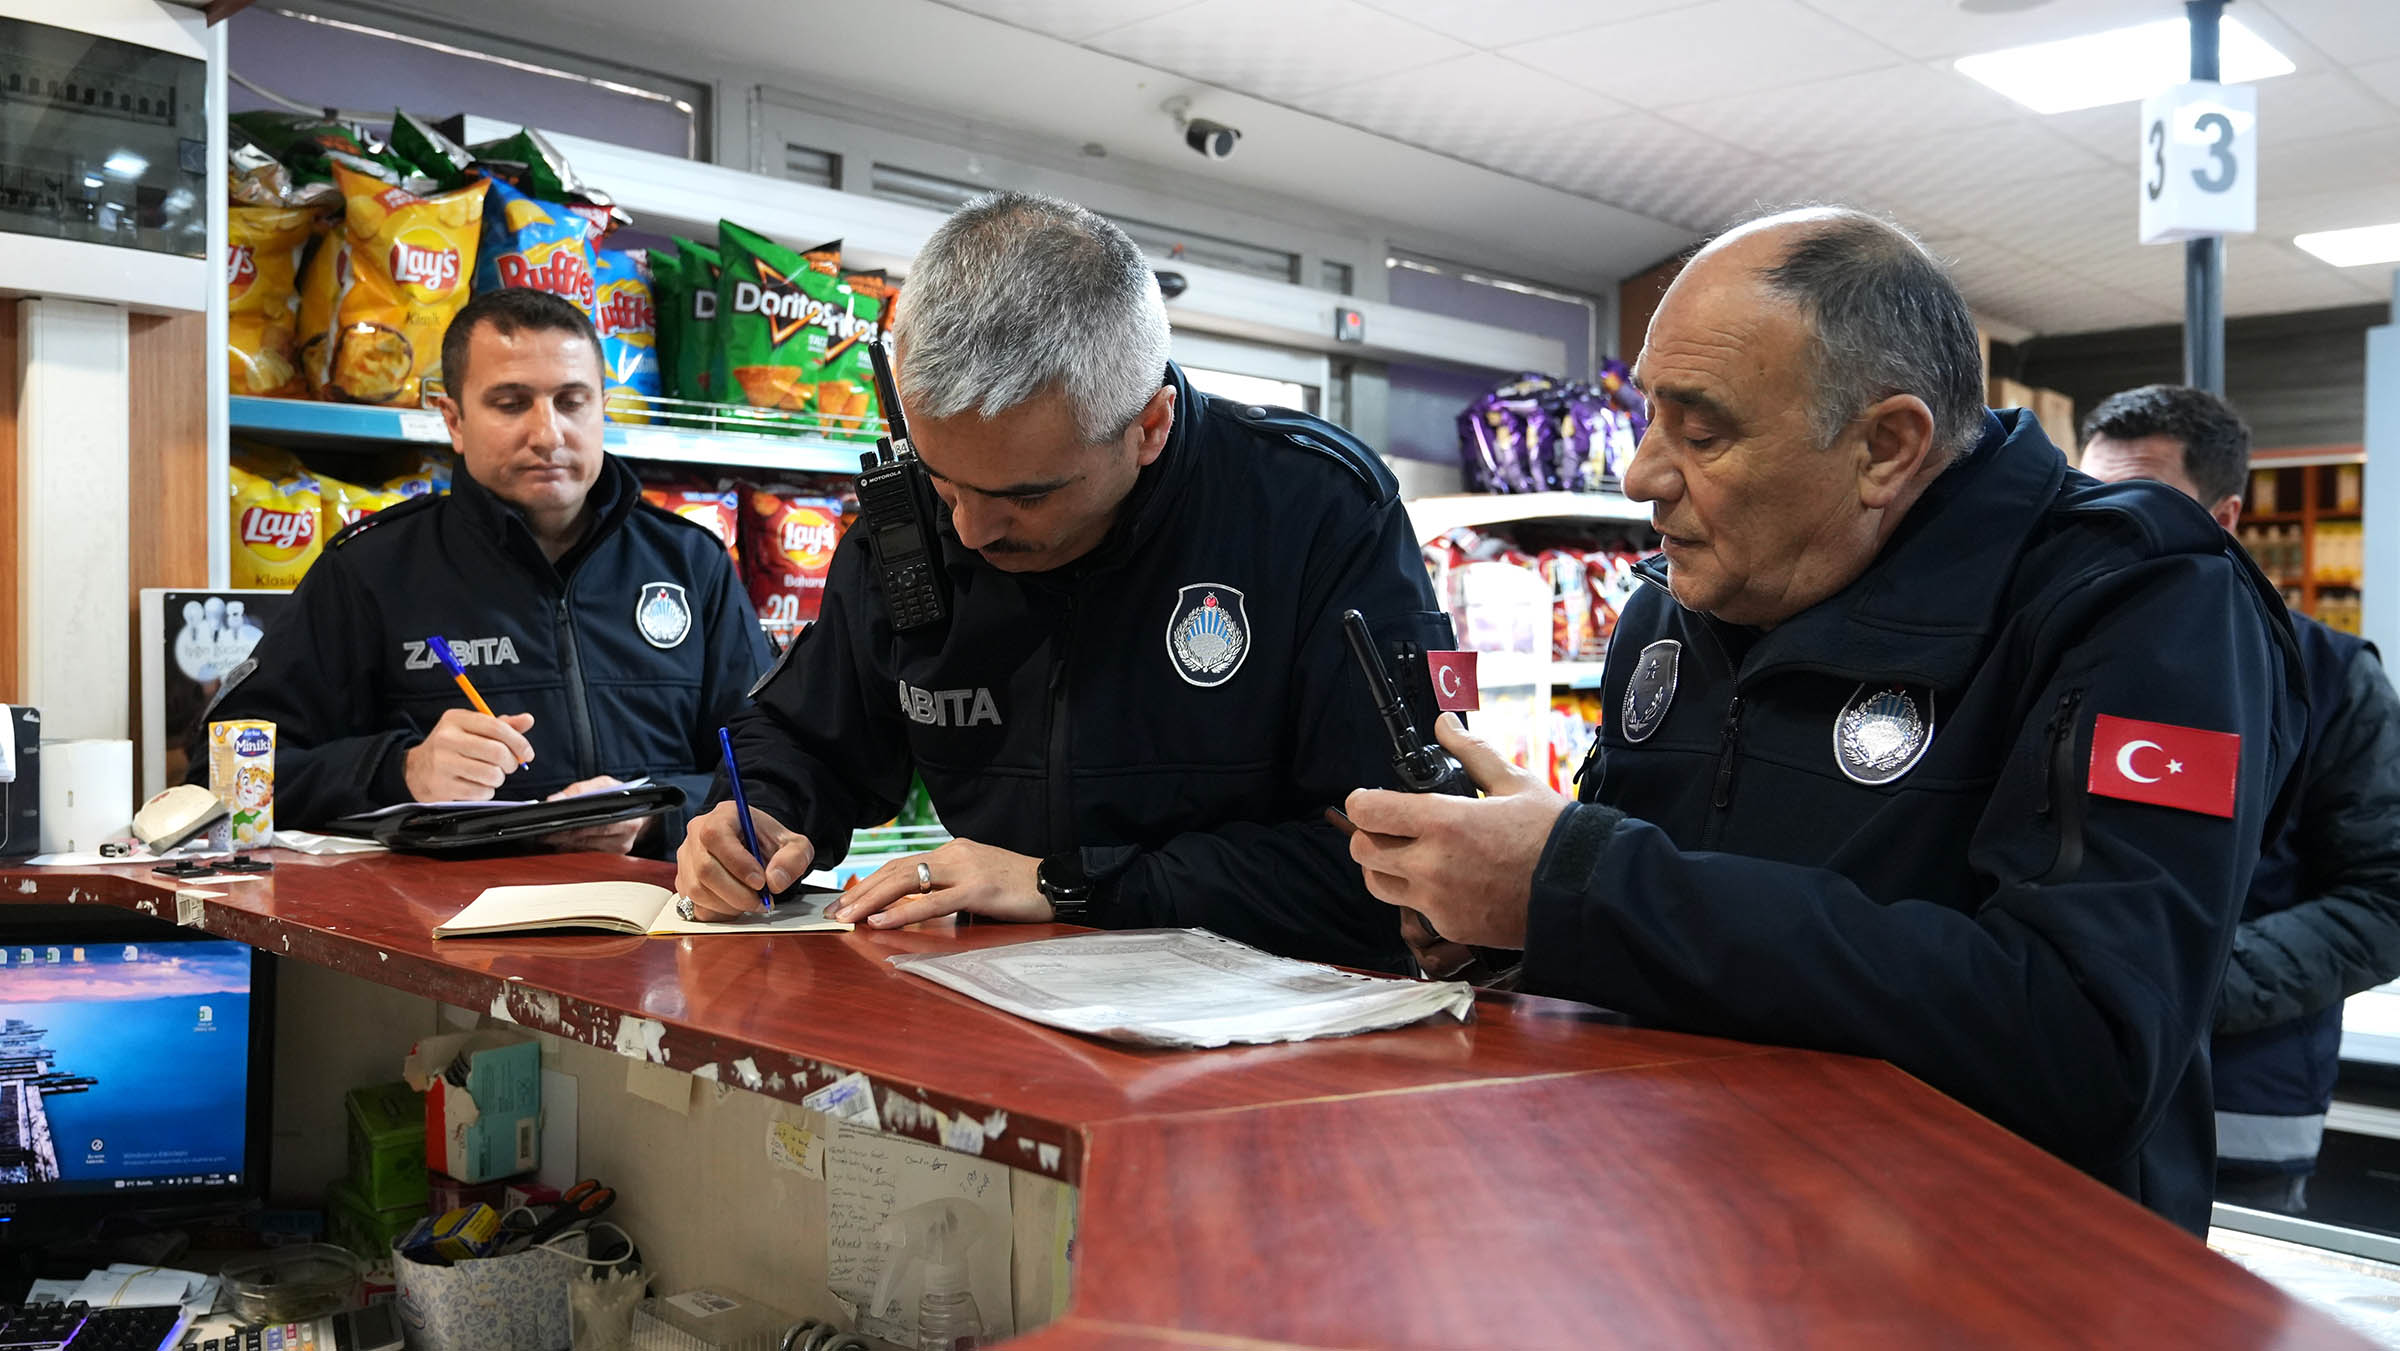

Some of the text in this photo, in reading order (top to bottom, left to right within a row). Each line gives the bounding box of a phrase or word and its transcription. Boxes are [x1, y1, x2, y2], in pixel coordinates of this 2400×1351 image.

[2148, 120, 2164, 200] 3
[2191, 112, 2238, 193] 3
[396, 242, 457, 290] Lay's
[497, 250, 595, 306] Ruffles
[596, 290, 656, 335] uffle
[734, 282, 833, 328] Doritos
[869, 470, 902, 483] MOTOROLA
[245, 507, 313, 549] Lay's
[784, 521, 836, 556] Lay's
[403, 636, 520, 670] ZABITA
[899, 680, 1002, 727] ABITA
[235, 739, 271, 753] Miniki
